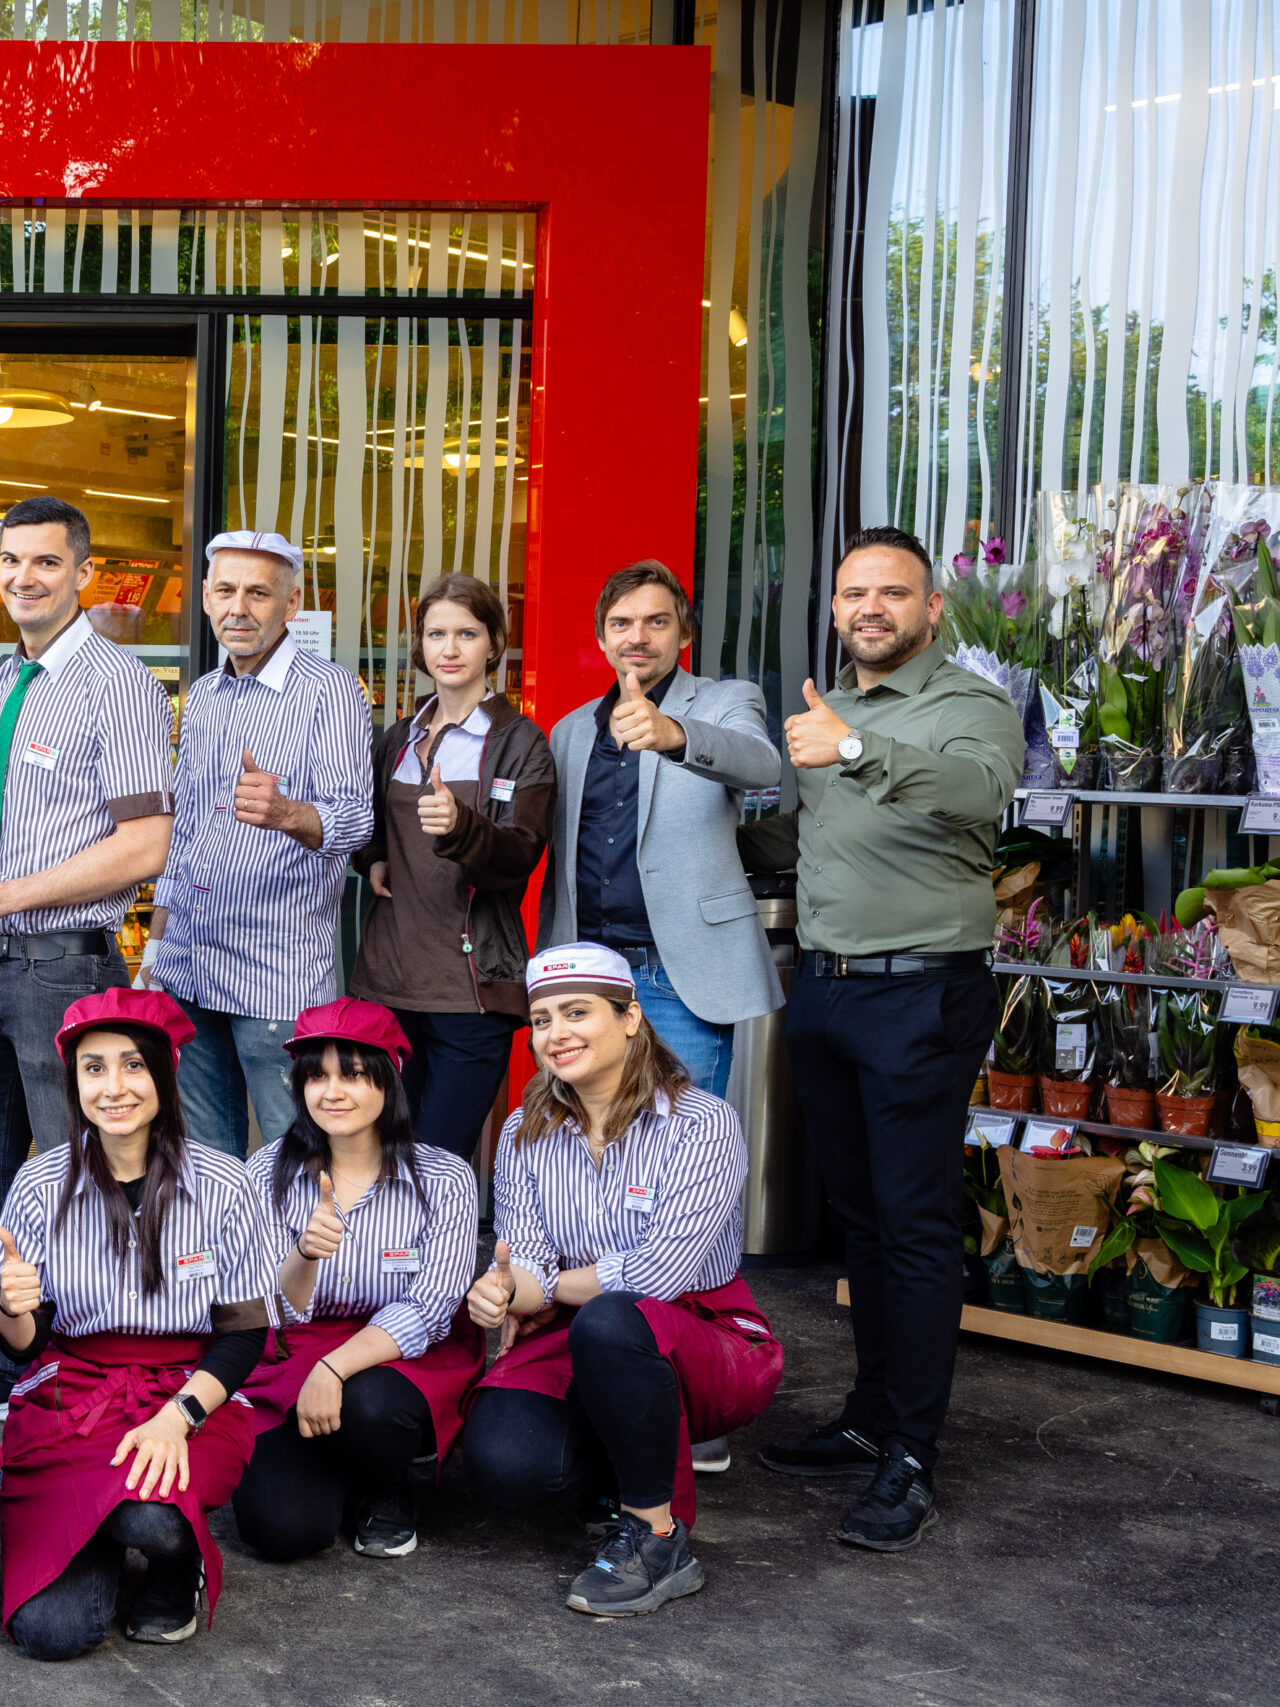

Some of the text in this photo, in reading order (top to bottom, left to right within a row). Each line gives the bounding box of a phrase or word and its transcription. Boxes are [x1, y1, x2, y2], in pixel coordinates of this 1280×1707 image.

[547, 963, 568, 971] SPAR
[1220, 1149, 1248, 1159] Sonnenb
[183, 1254, 205, 1265] SPAR
